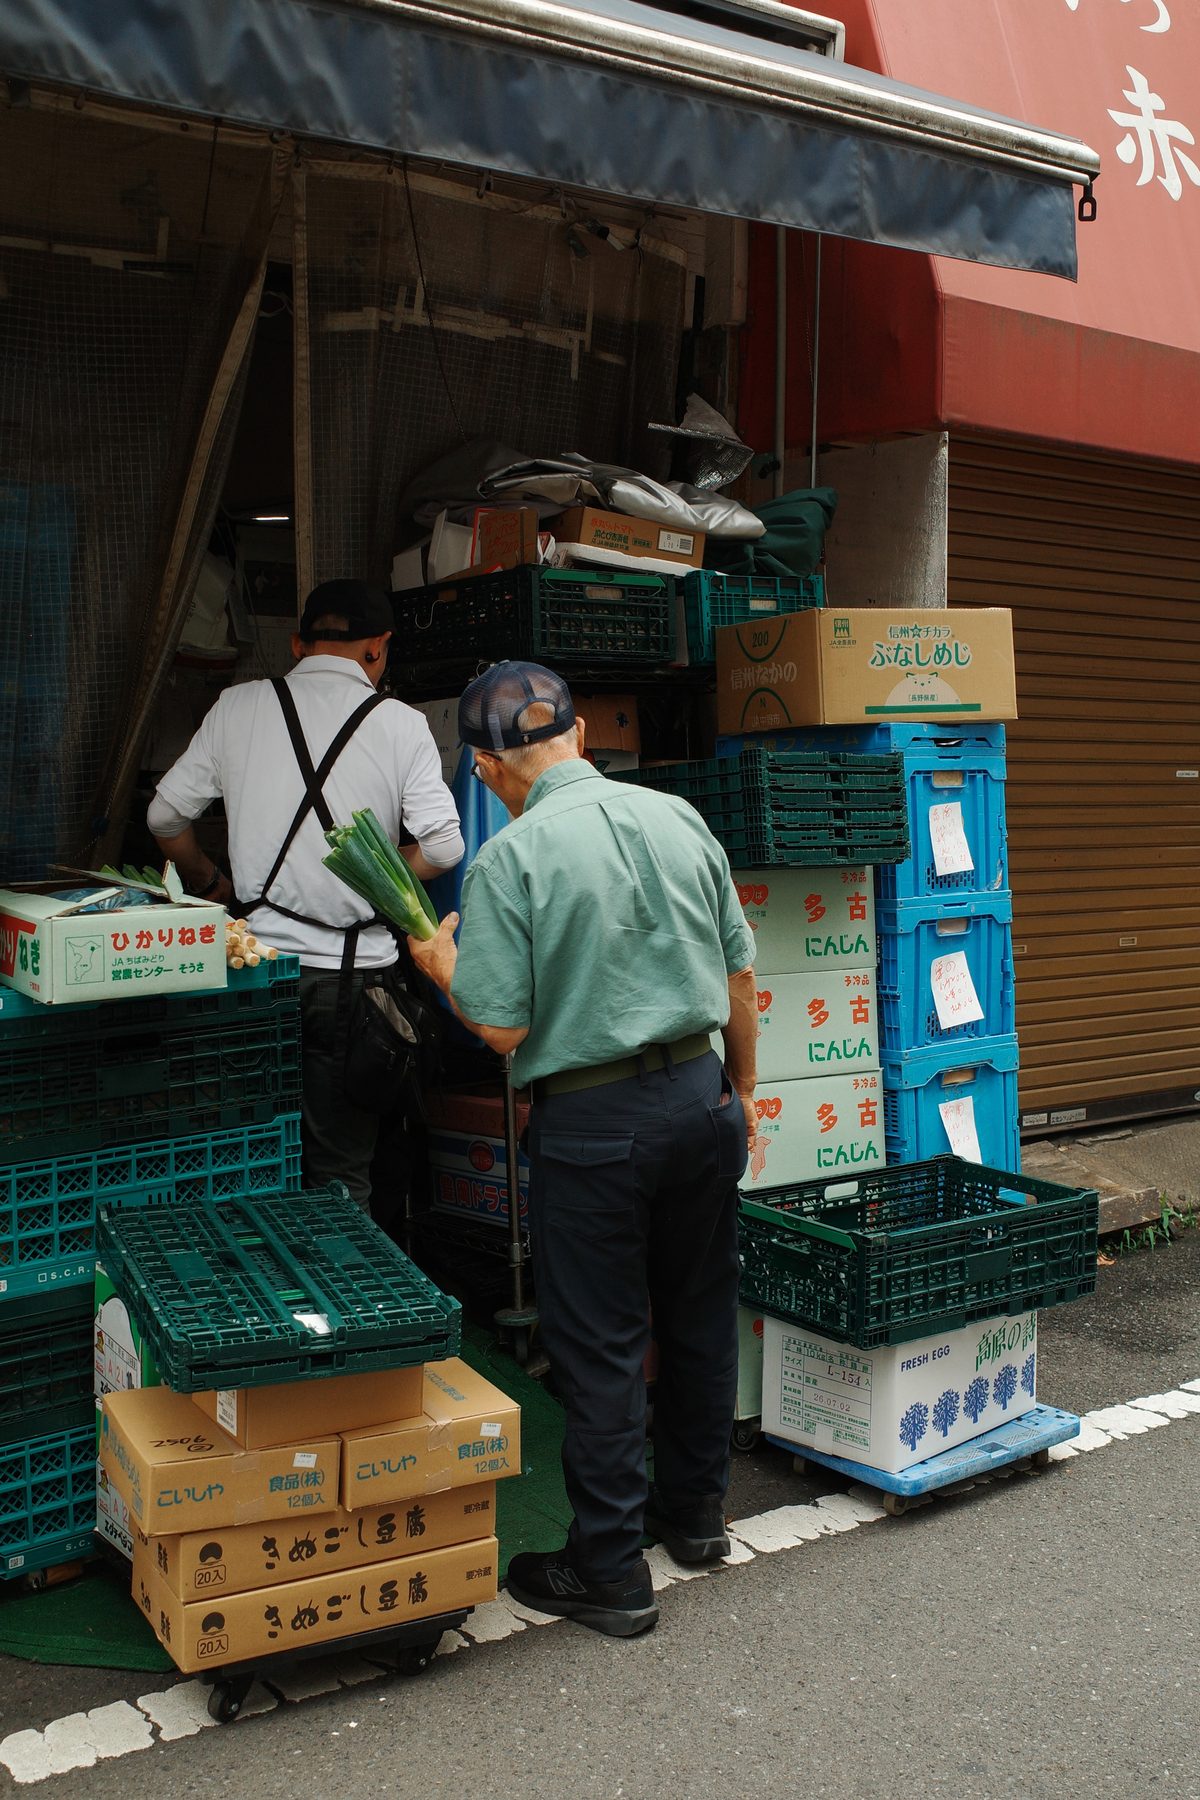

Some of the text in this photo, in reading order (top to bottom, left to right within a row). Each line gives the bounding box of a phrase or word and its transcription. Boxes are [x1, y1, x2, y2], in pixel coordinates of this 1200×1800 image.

[752, 631, 769, 648] 200
[870, 642, 971, 668] ぶなしめじ
[731, 661, 798, 690] 信州なかの
[841, 872, 867, 884] 予冷品
[804, 891, 867, 923] 多古
[111, 923, 217, 952] ひかりねぎ
[805, 934, 869, 958] にんじん
[111, 961, 206, 982] 営農センター そうさ
[112, 954, 165, 967] JA ちばみどり
[844, 974, 870, 987] 予冷品
[807, 995, 870, 1028] 多古
[808, 1038, 873, 1063] にんじん
[852, 1077, 878, 1090] 予冷品
[817, 1097, 878, 1134] 多古
[816, 1140, 879, 1168] にんじん
[975, 1312, 1037, 1372] 高原の詩
[784, 1355, 802, 1366] サイズ
[900, 1344, 951, 1372] FRESH EGG
[356, 1455, 417, 1480] こいしや
[474, 1457, 510, 1474] 12個入
[157, 1483, 224, 1508] こいしや
[287, 1495, 325, 1509] 12個入
[262, 1500, 490, 1570] きぬごし豆腐 要冷蔵
[196, 1570, 224, 1586] 20入
[264, 1566, 492, 1639] きぬごし豆腐 要冷蔵
[199, 1639, 227, 1656] 20入
